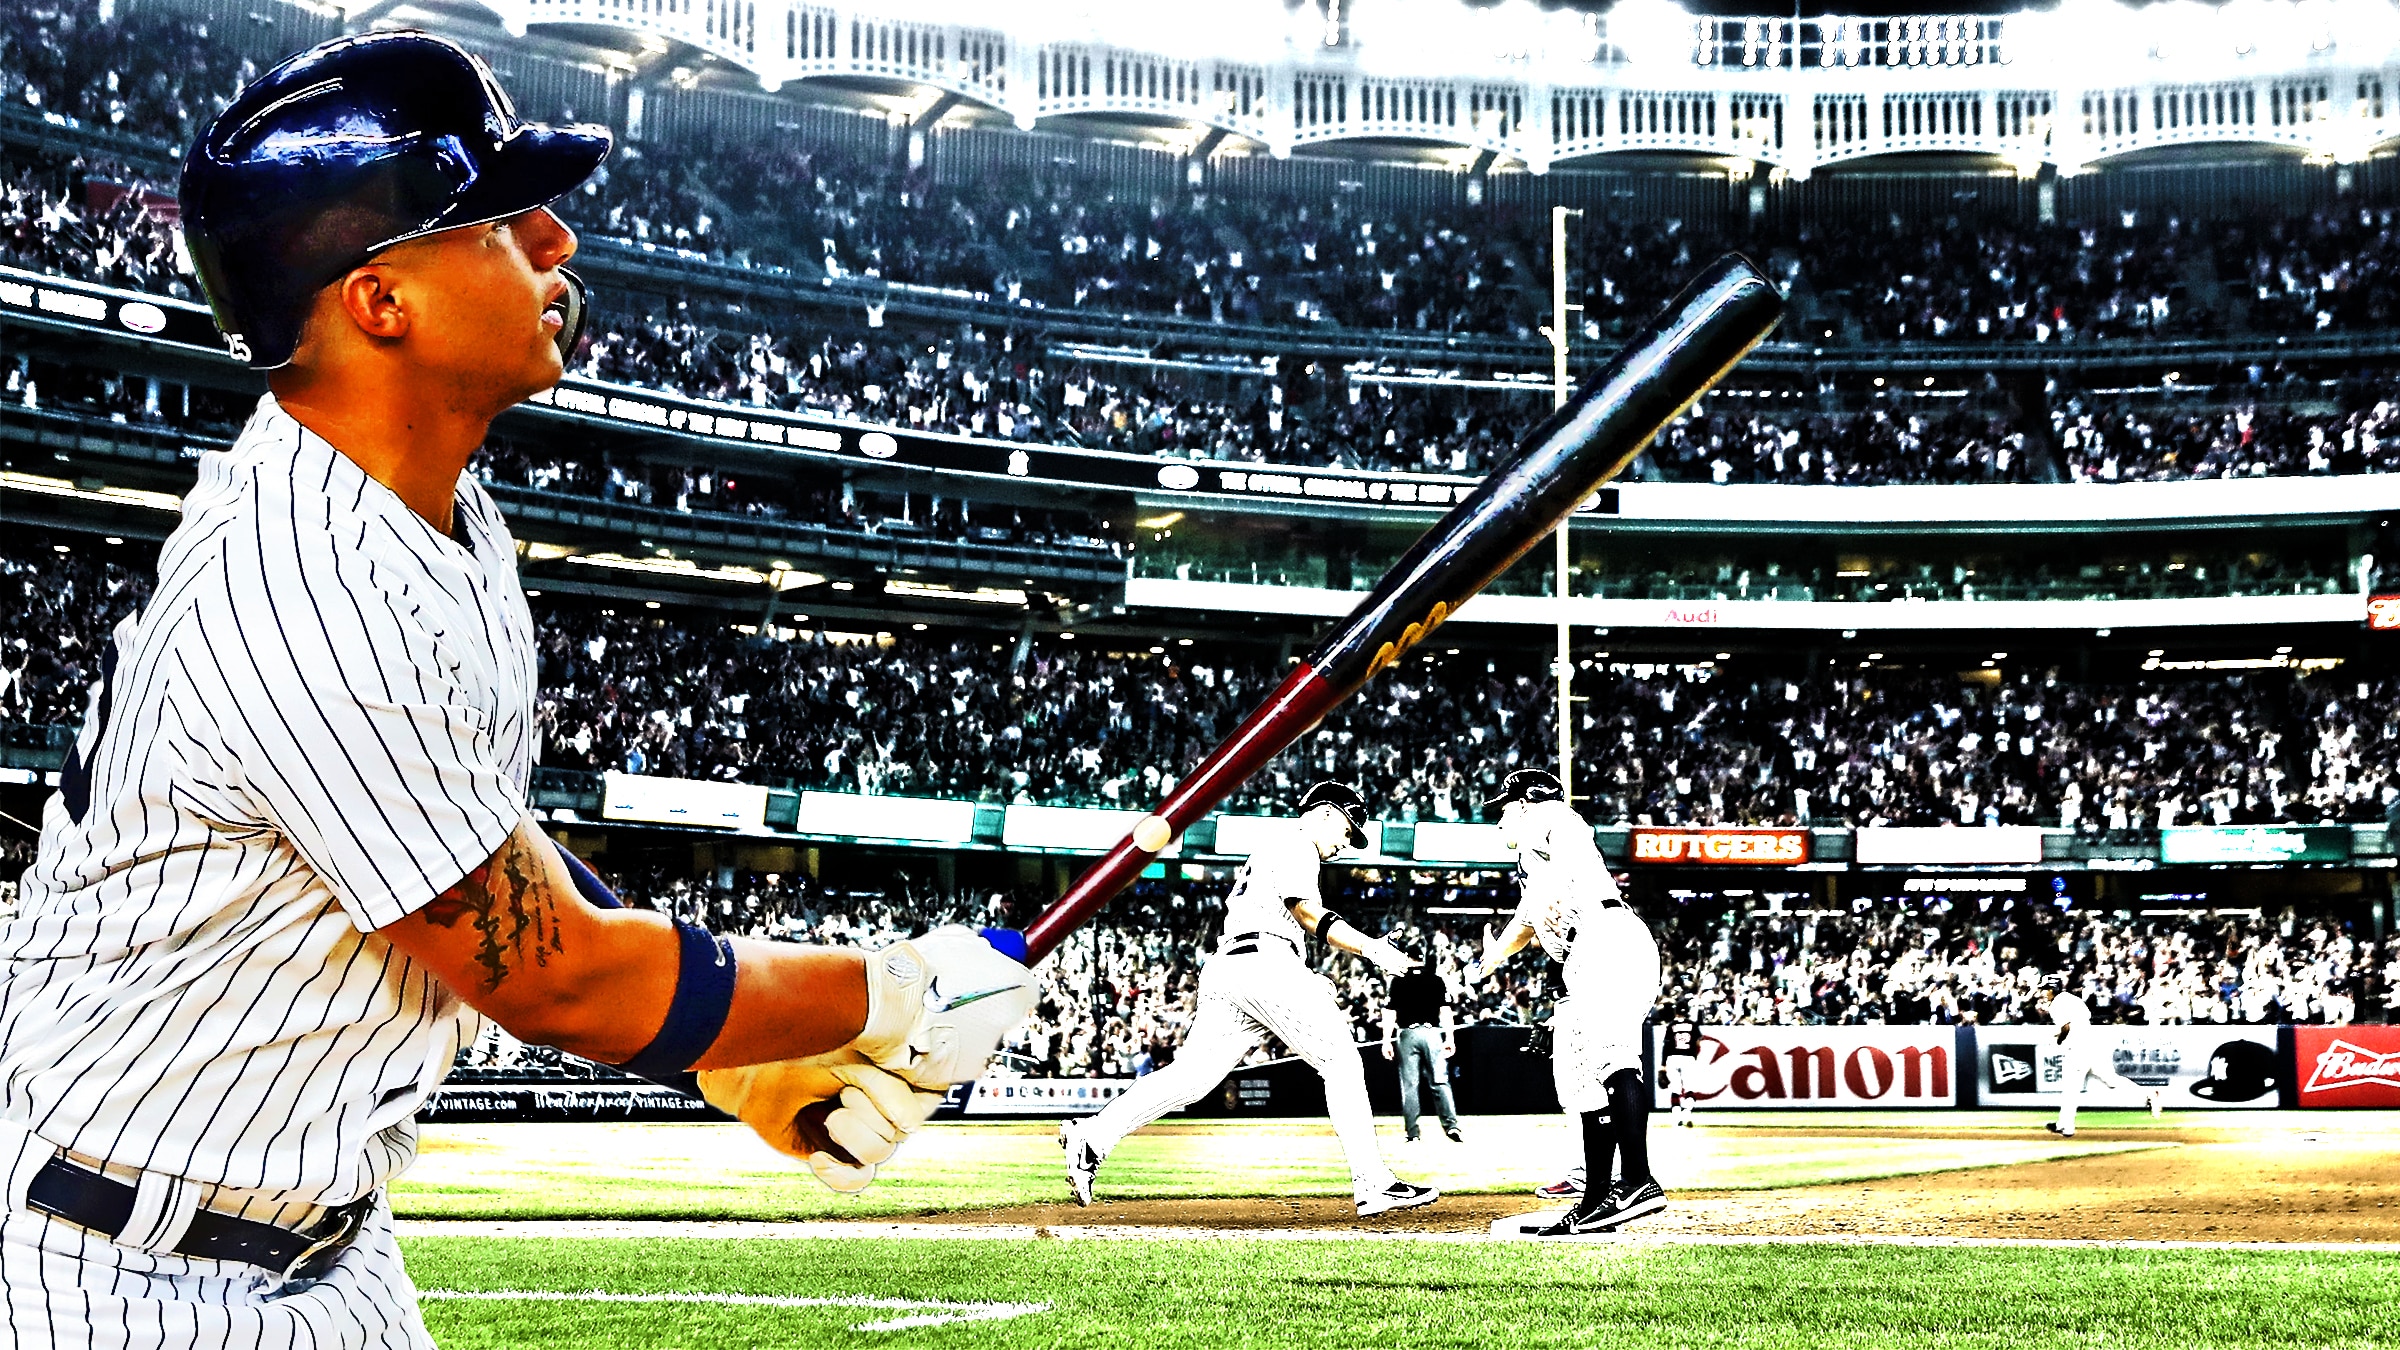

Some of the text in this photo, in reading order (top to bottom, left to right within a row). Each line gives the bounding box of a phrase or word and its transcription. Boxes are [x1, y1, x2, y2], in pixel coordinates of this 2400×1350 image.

[223, 333, 252, 362] 25
[1664, 608, 1718, 624] Audi
[1635, 833, 1803, 860] RUTGERS
[2043, 1054, 2064, 1067] NE
